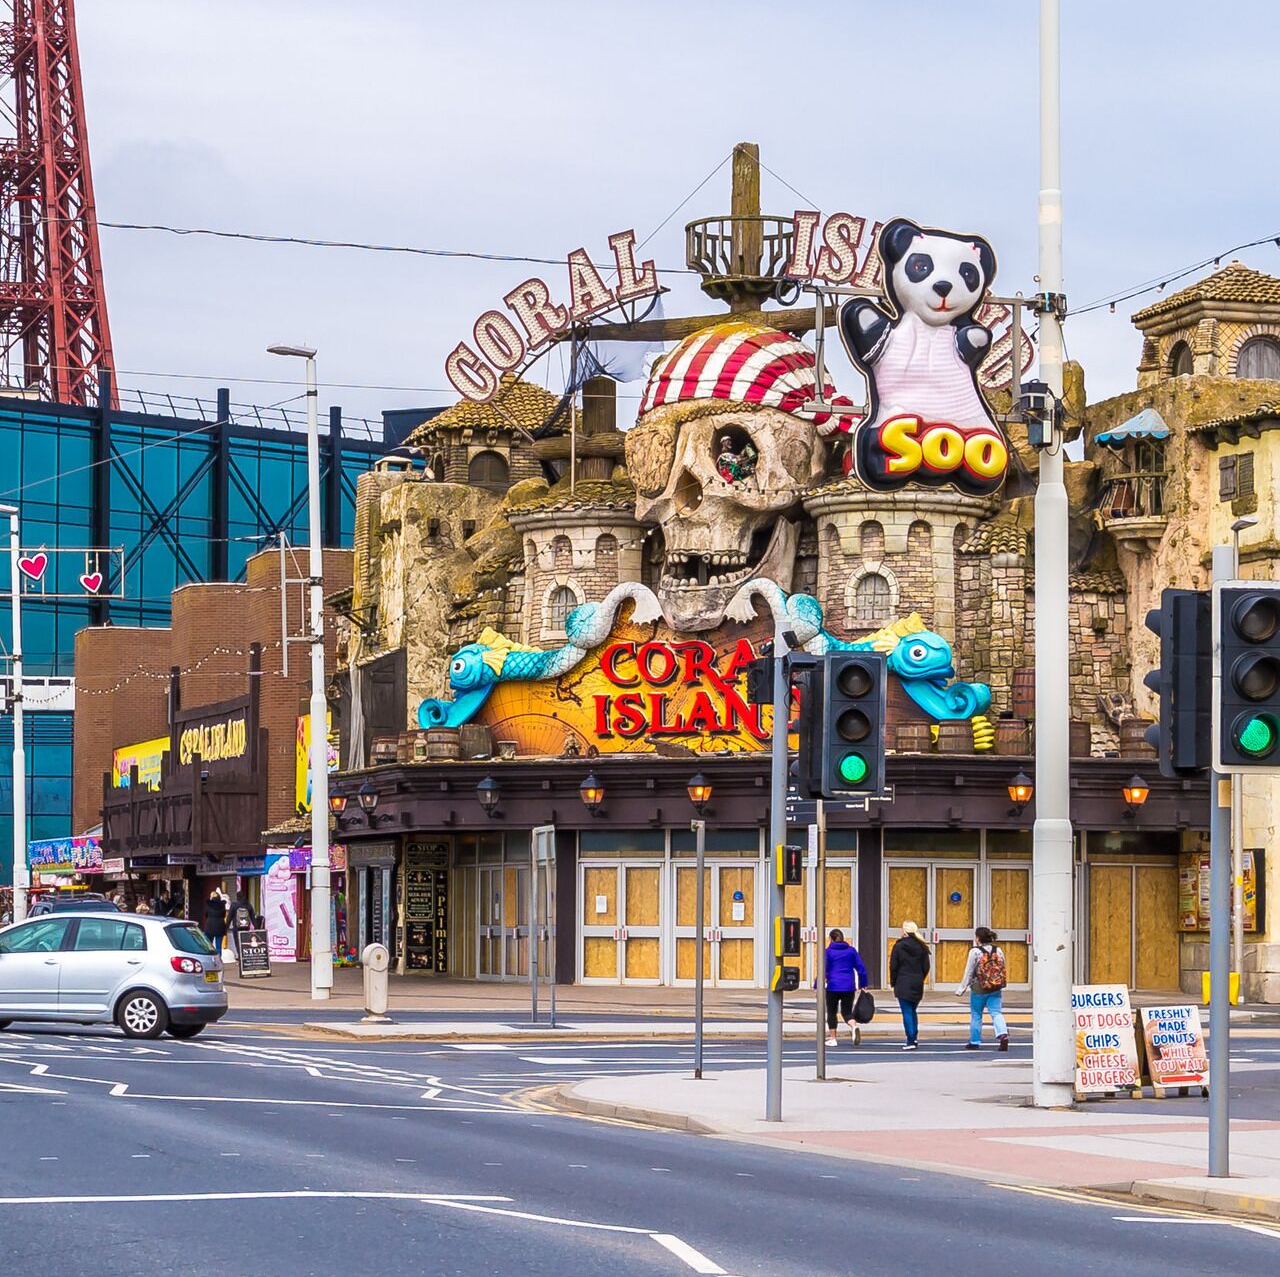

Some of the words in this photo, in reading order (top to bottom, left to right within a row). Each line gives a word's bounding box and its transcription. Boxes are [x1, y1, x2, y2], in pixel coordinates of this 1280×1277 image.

[445, 229, 660, 404] CORAL
[881, 415, 1008, 479] SOO
[600, 636, 776, 691] CORA
[593, 688, 800, 739] ISLAN
[211, 718, 247, 762] ISLAND
[272, 935, 289, 946] Ice
[436, 896, 446, 971] Palmist
[1072, 993, 1123, 1008] BURGERS
[1097, 1013, 1130, 1027] DOGS
[1148, 1008, 1191, 1020] FRESHLY
[1158, 1020, 1186, 1031] MADE
[1085, 1034, 1119, 1048] CHIPS
[1153, 1033, 1195, 1045] DONUTS
[1160, 1046, 1193, 1058] WHILE
[1084, 1054, 1126, 1069] CHEESE
[1153, 1061, 1177, 1071] YOU
[1179, 1059, 1205, 1071] WAIT
[1081, 1070, 1135, 1086] BURGERS
